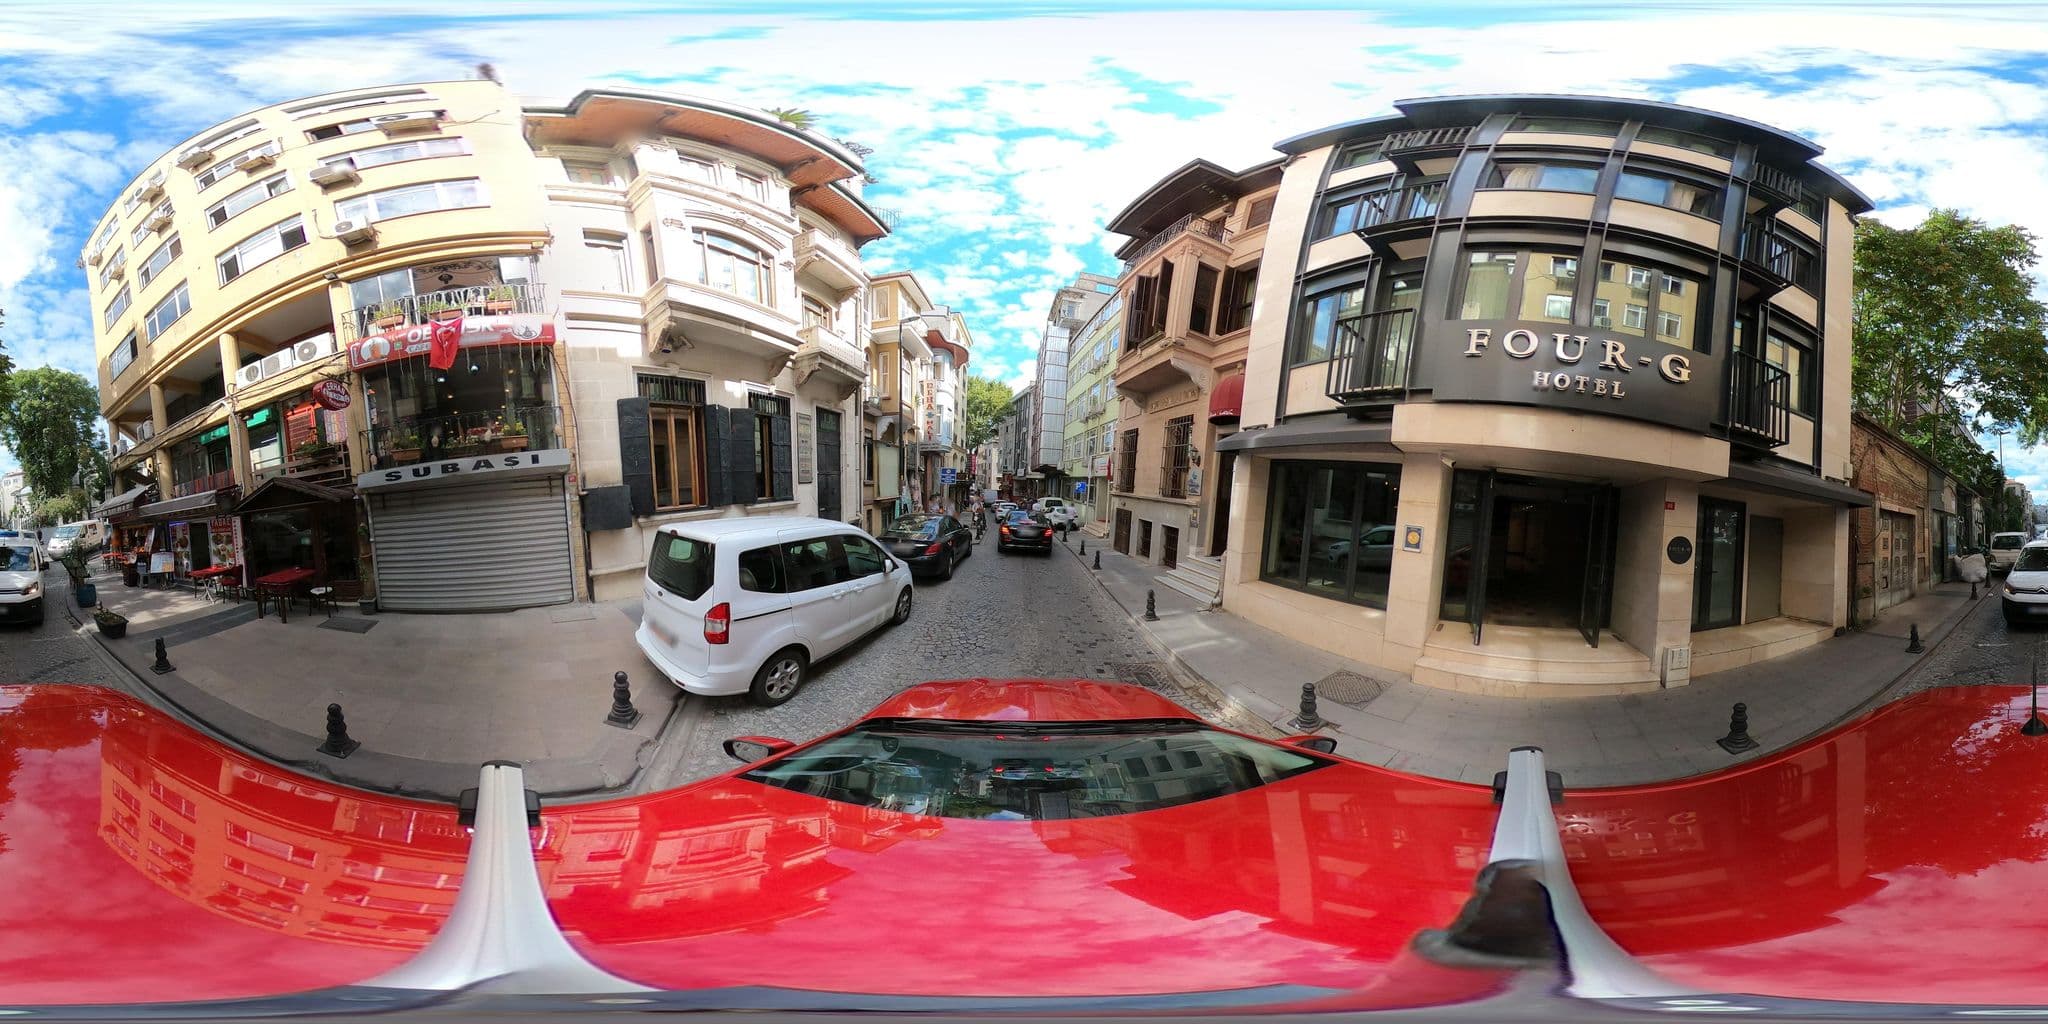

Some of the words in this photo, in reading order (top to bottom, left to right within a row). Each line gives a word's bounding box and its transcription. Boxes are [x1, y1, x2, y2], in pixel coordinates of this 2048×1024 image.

[1464, 328, 1692, 384] FOUR-G
[1533, 370, 1626, 399] HOTEL
[385, 453, 540, 482] SUBAŞI
